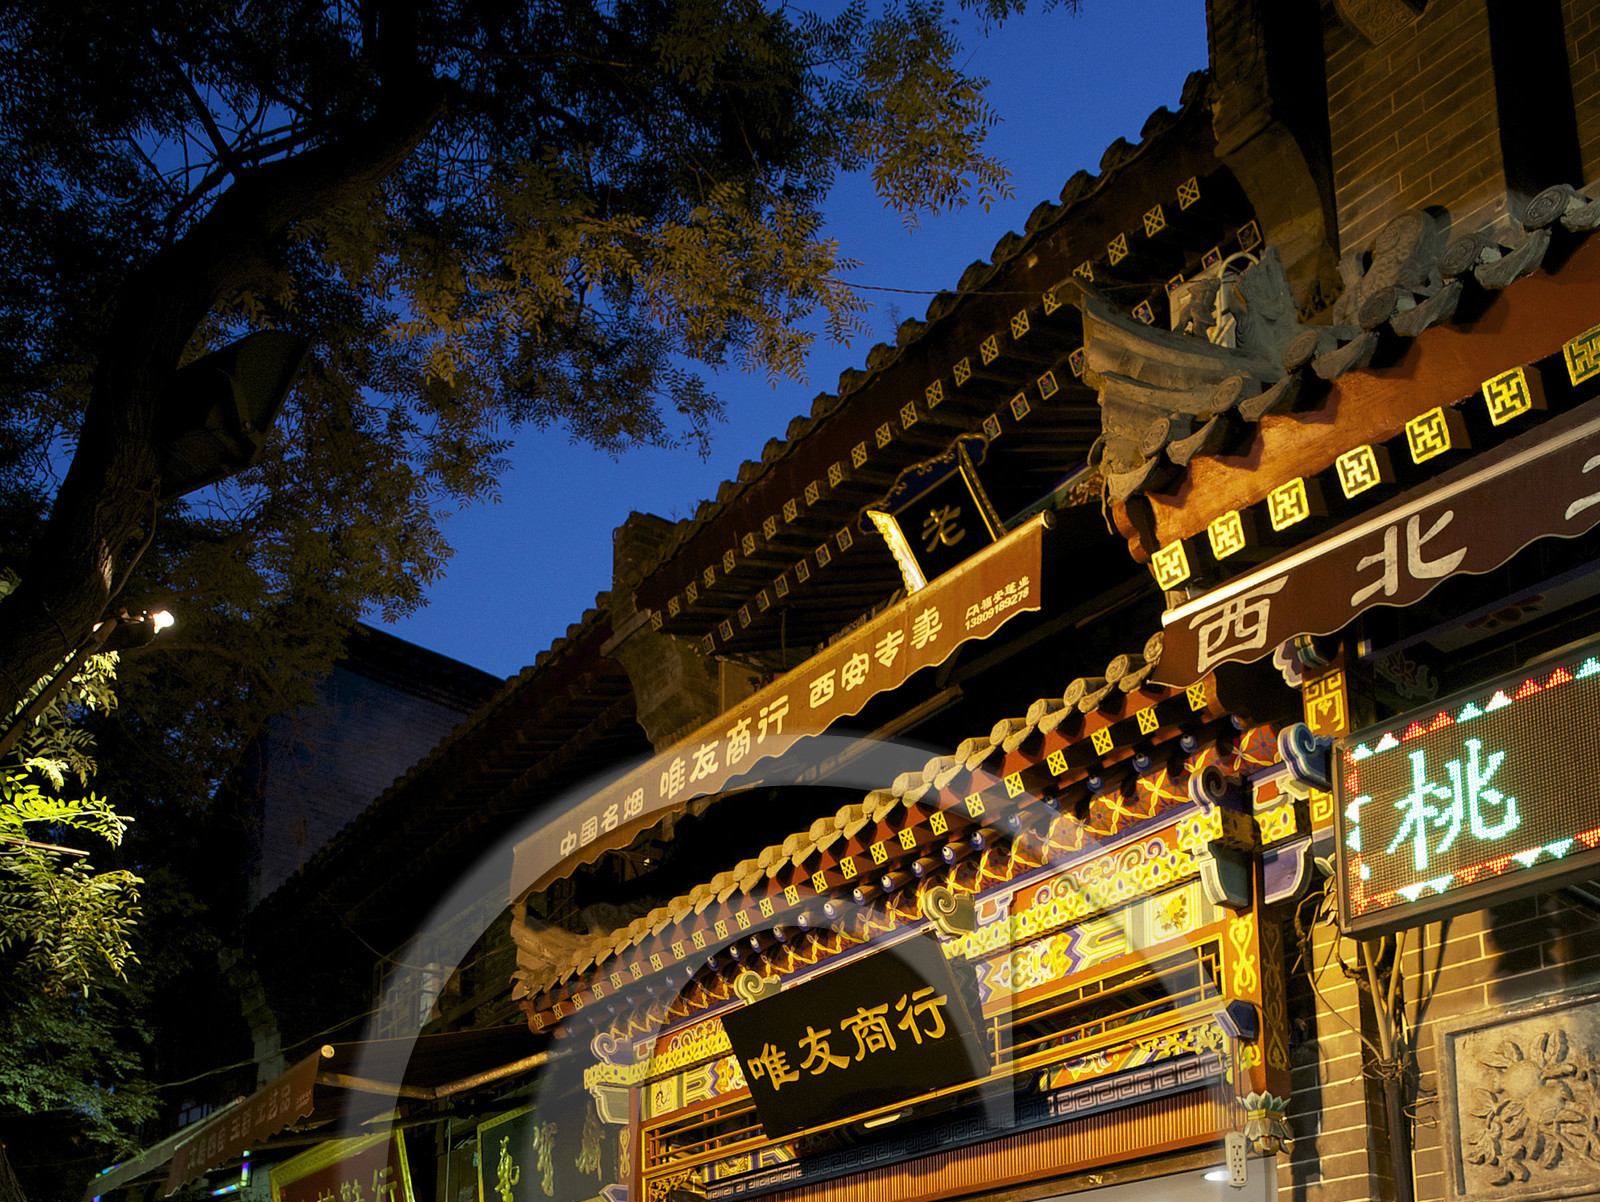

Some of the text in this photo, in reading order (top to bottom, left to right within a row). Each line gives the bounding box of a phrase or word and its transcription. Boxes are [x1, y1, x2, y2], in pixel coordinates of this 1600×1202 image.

[964, 586, 1030, 631] 13809189278
[560, 605, 943, 857] 中国名烟 唯友商行 西安专卖
[1386, 738, 1521, 871] 桃
[746, 985, 948, 1091] 唯友商行
